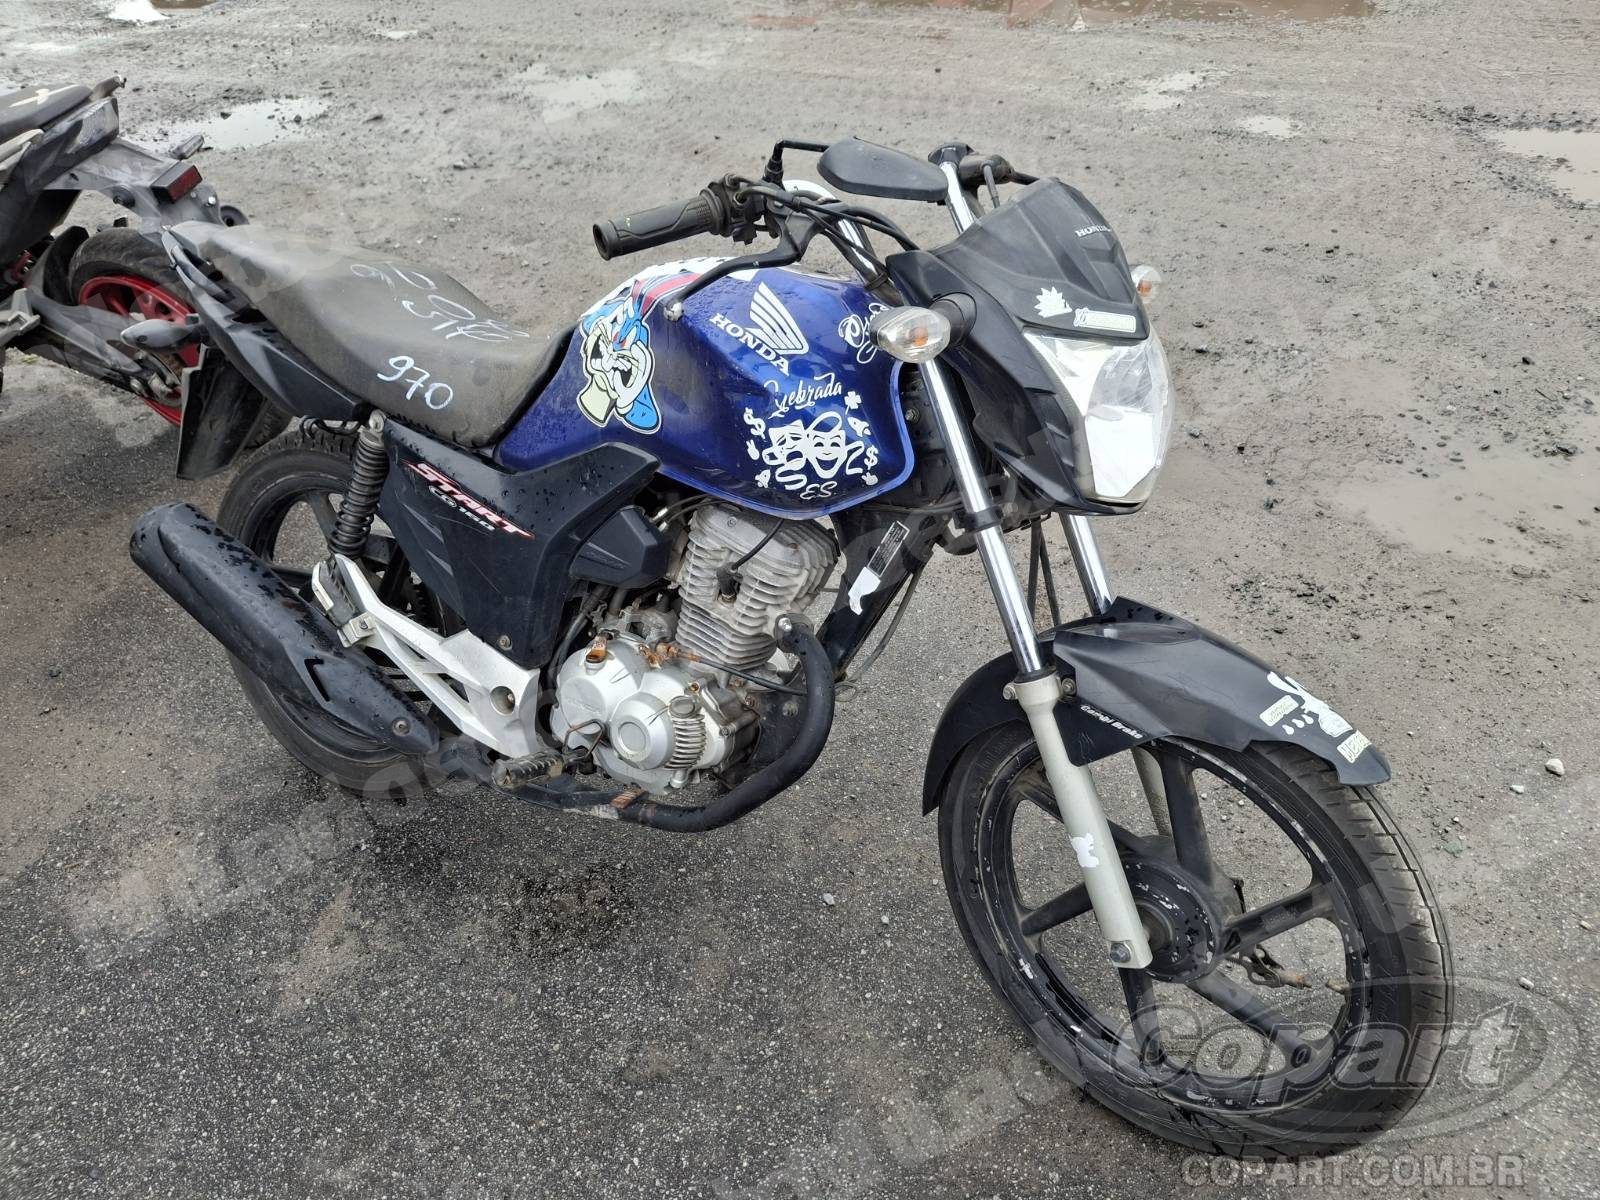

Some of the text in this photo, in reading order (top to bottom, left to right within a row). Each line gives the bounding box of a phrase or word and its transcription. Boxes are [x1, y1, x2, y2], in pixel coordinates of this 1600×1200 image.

[709, 313, 790, 376] HONDA
[376, 355, 454, 410] 970
[402, 461, 535, 539] START
